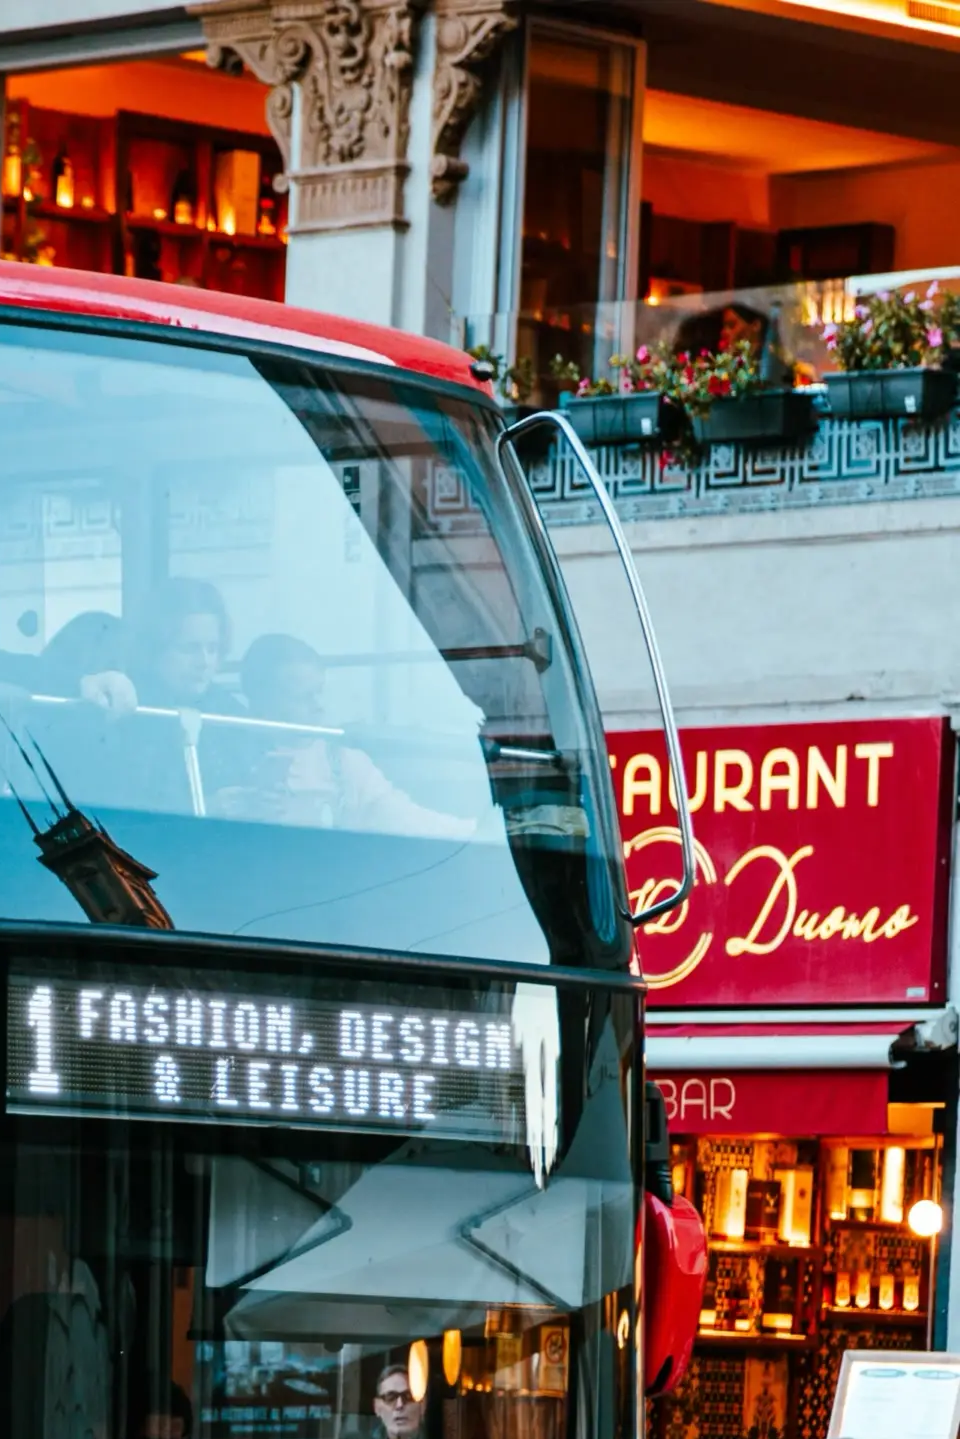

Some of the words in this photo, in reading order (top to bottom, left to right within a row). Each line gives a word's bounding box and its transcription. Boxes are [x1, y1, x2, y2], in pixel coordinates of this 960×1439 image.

[610, 742, 895, 817] AURANT
[725, 845, 919, 957] Duomo
[28, 986, 60, 1094] 1
[78, 988, 315, 1054] FASHION,
[341, 1010, 512, 1070] DESIGN
[213, 1057, 437, 1121] LEISURE
[654, 1078, 736, 1120] BAR
